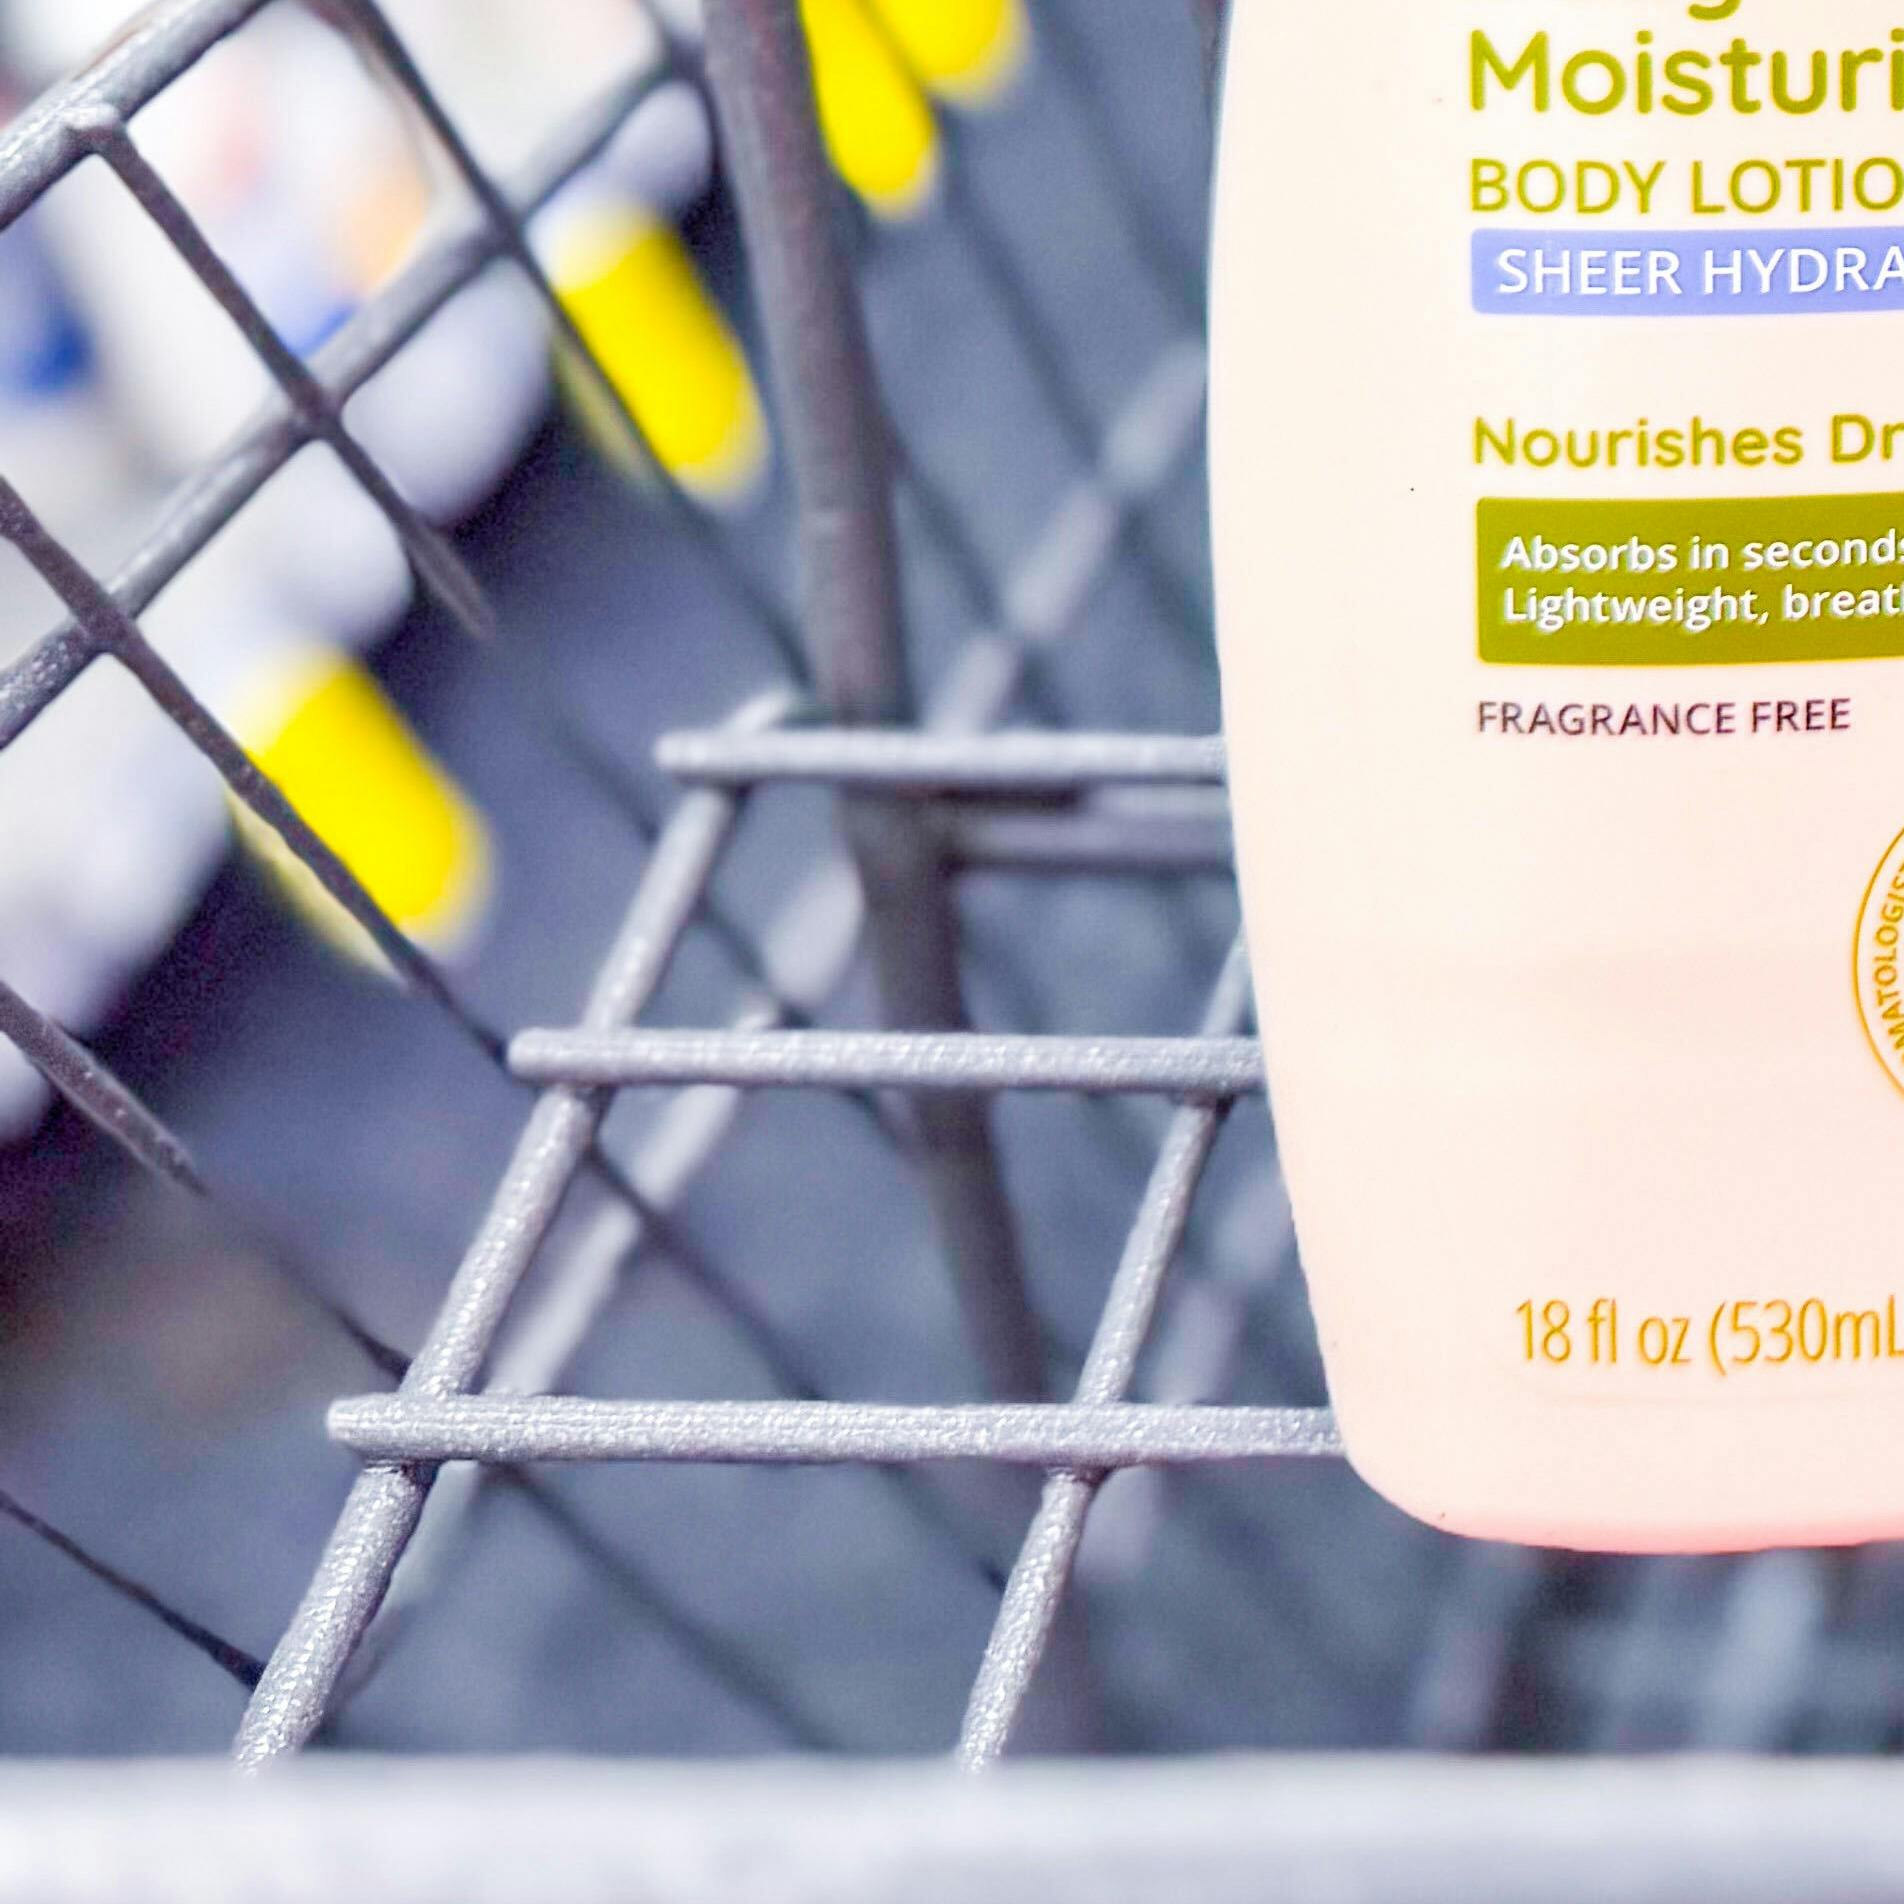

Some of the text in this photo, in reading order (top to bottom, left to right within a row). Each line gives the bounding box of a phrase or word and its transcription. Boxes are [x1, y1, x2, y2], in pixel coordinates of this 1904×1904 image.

[1470, 158, 1665, 214] BODY
[1497, 249, 1684, 296] SHEER
[1473, 416, 1803, 468] Nourishes
[1500, 535, 1677, 573] Absorbs
[1689, 536, 1728, 569] in
[1504, 586, 1768, 634] Lightweight,
[1479, 699, 1849, 735] FRAGRANCE FREE
[1517, 1300, 1571, 1364] 18
[1587, 1298, 1617, 1364] fl
[1638, 1317, 1689, 1366] oz
